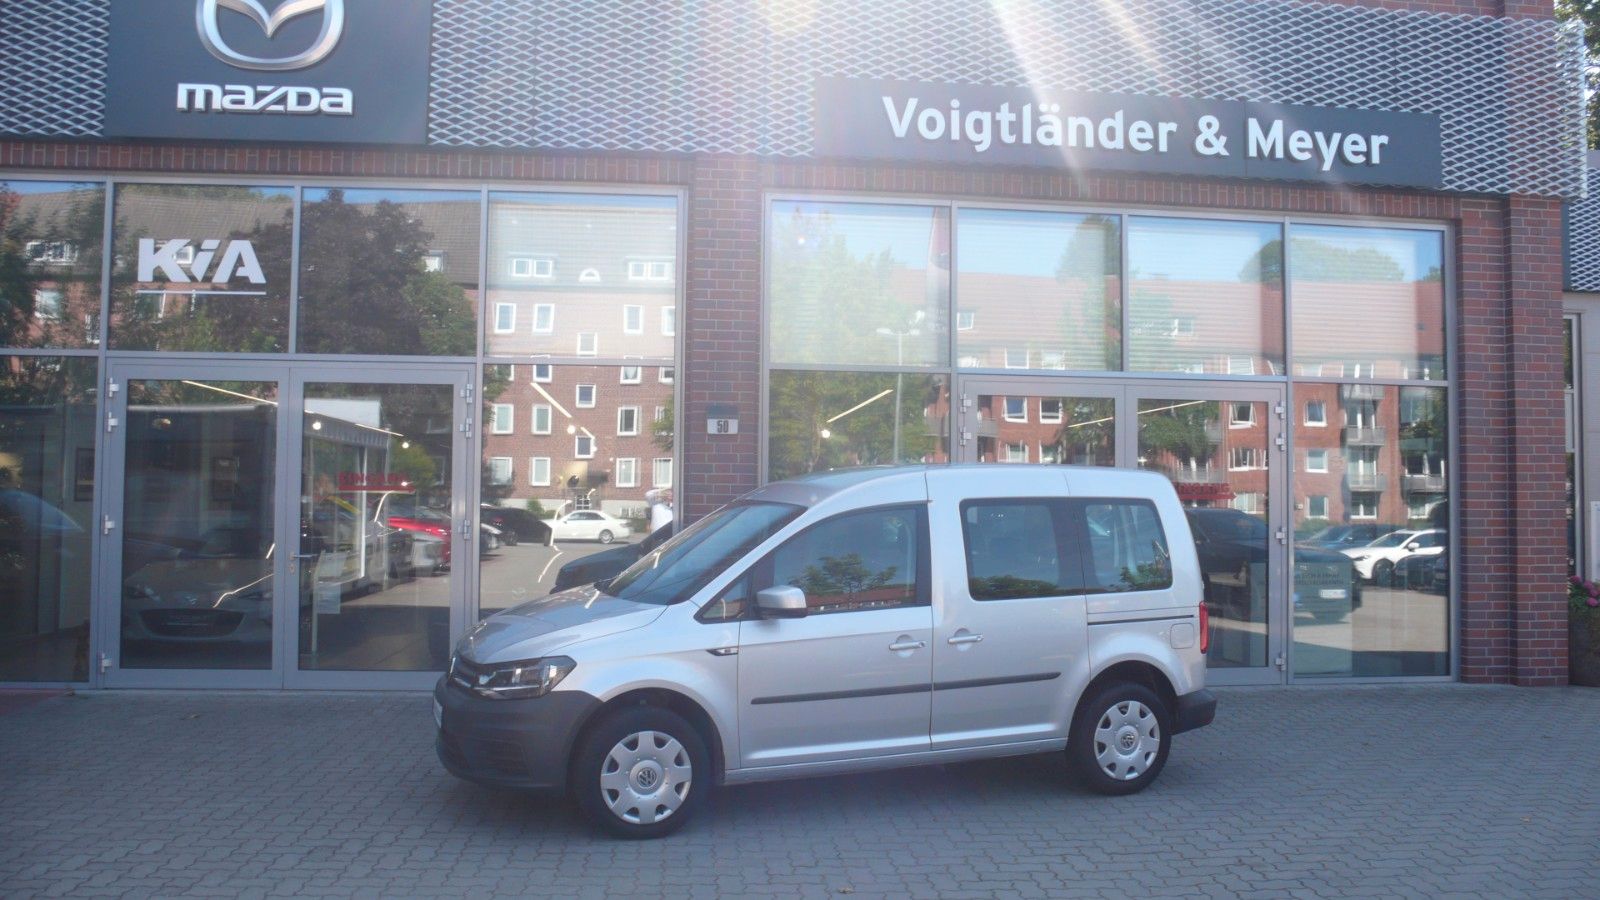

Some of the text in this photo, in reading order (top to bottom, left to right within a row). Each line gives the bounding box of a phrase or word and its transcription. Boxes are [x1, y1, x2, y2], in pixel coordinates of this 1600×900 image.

[882, 96, 1389, 171] Voigtländer & Meyer
[716, 419, 729, 433] 50
[1173, 482, 1232, 495] INGANG
